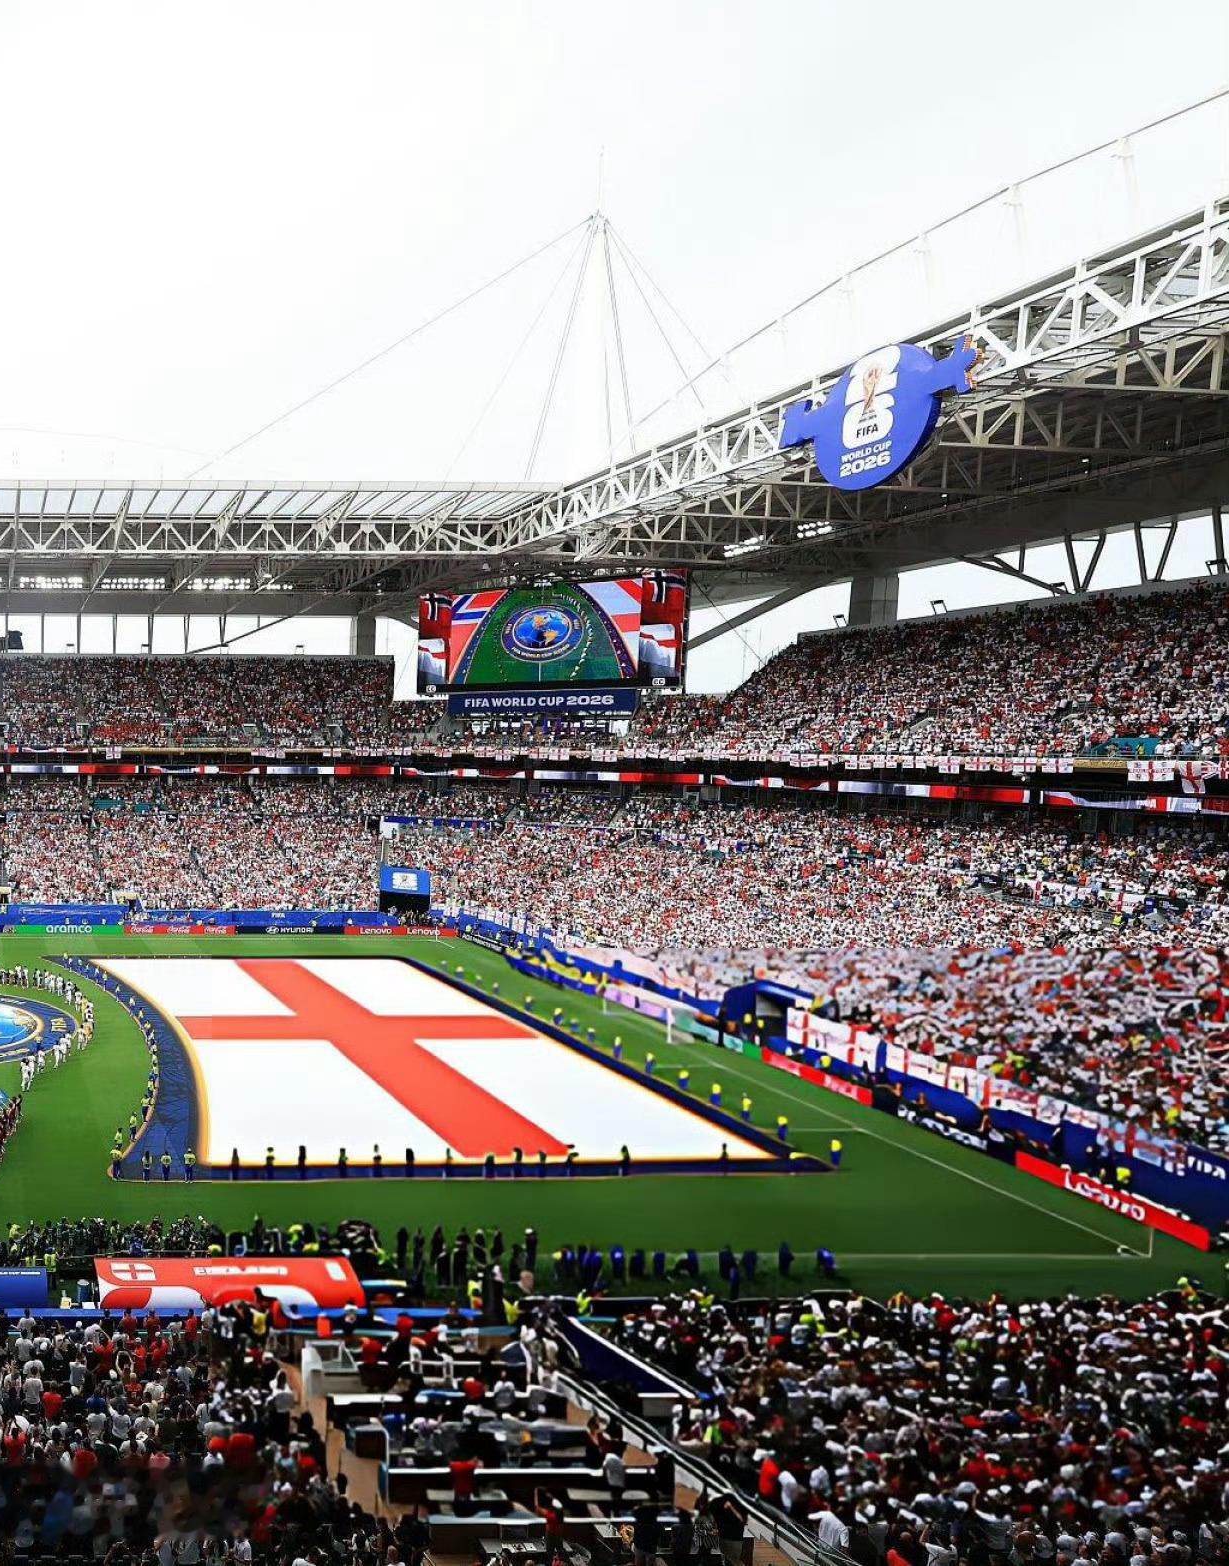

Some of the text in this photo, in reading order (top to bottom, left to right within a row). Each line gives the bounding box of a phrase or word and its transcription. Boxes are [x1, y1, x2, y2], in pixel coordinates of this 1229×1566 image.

[857, 423, 878, 438] FIFA
[841, 440, 892, 463] WORLD CUP
[840, 450, 891, 478] 2026
[464, 695, 615, 708] FIFA WORLD CUP 2026
[45, 924, 93, 934] aramco
[359, 926, 392, 935] Lenovo
[406, 927, 441, 936] Lenovo
